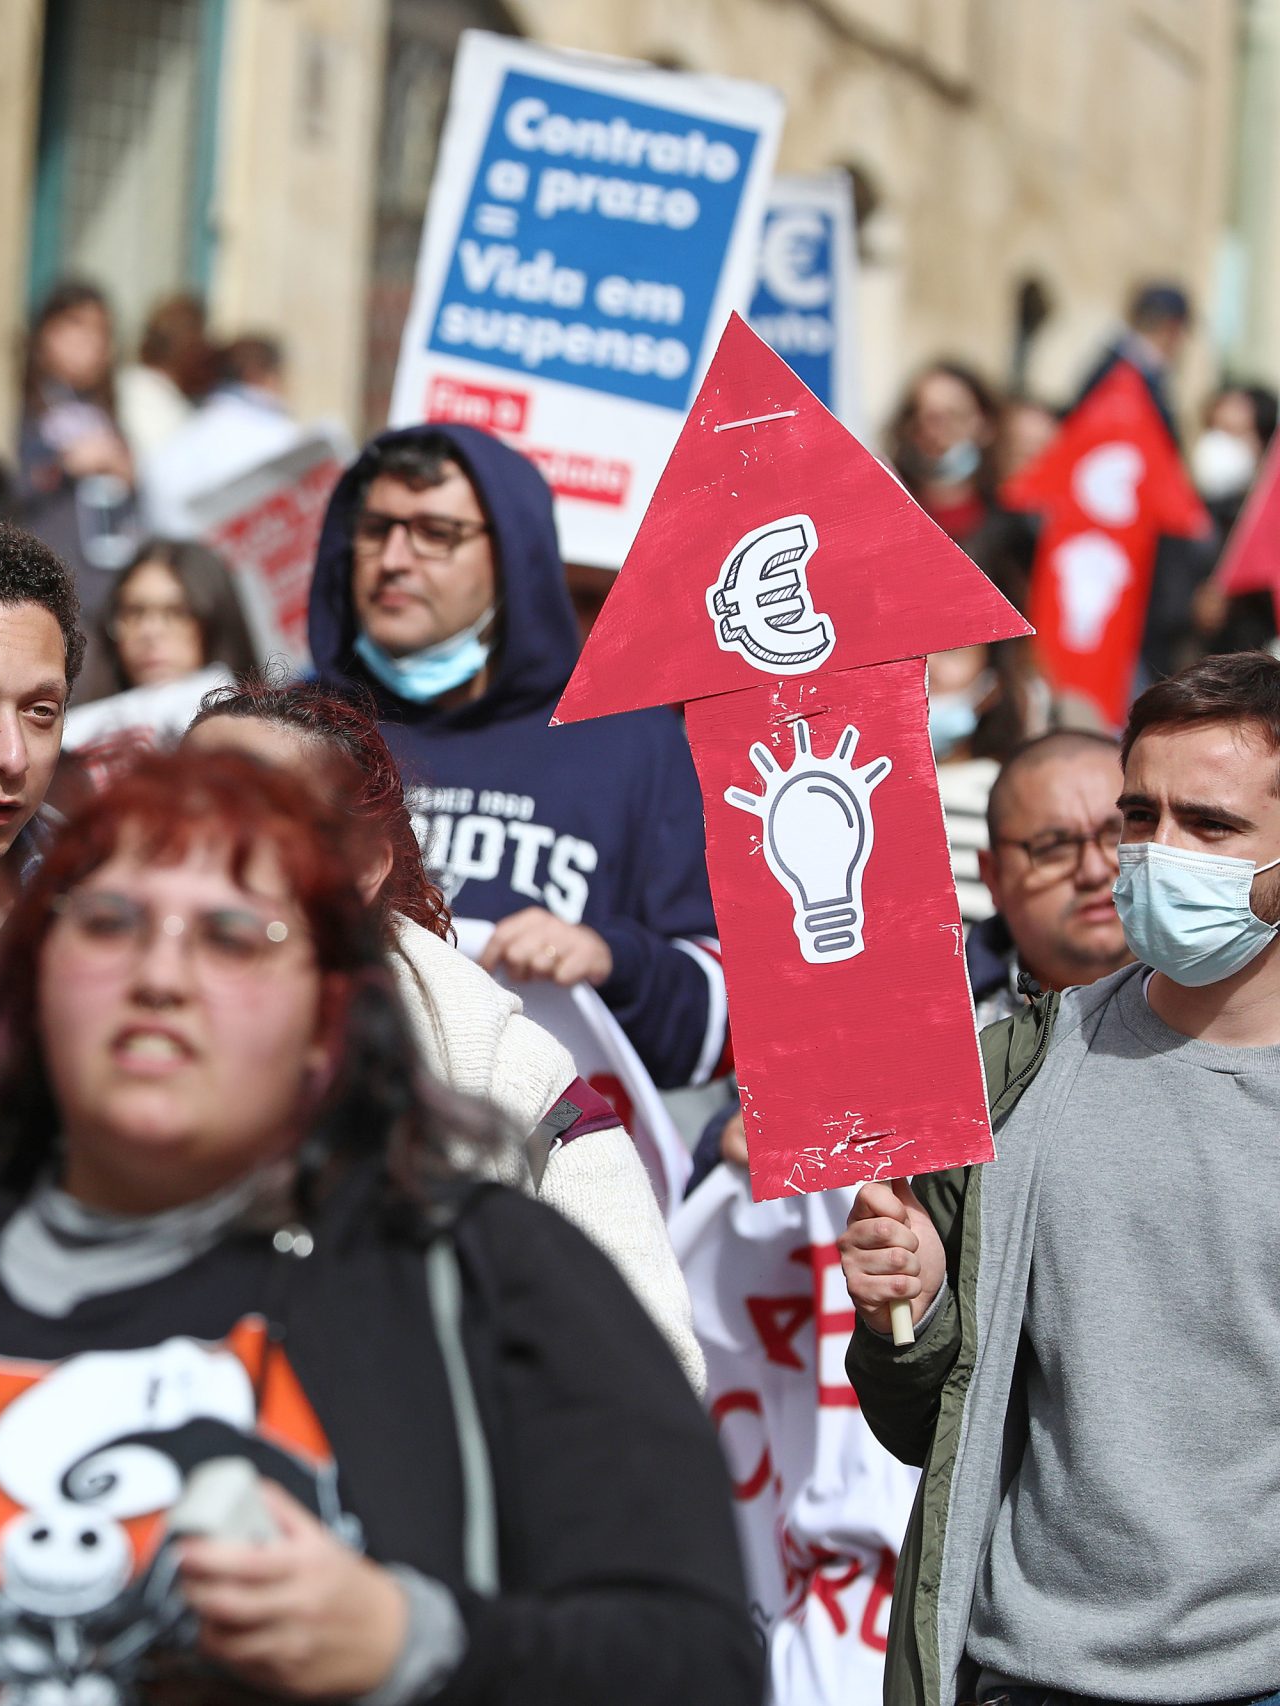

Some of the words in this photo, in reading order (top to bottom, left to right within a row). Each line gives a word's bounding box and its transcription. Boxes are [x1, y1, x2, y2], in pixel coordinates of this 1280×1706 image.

[504, 98, 740, 183] Contrato
[486, 161, 529, 198] a
[536, 168, 699, 229] prazo
[460, 240, 586, 310] Vida
[595, 273, 685, 324] em
[439, 302, 690, 379] suspenso
